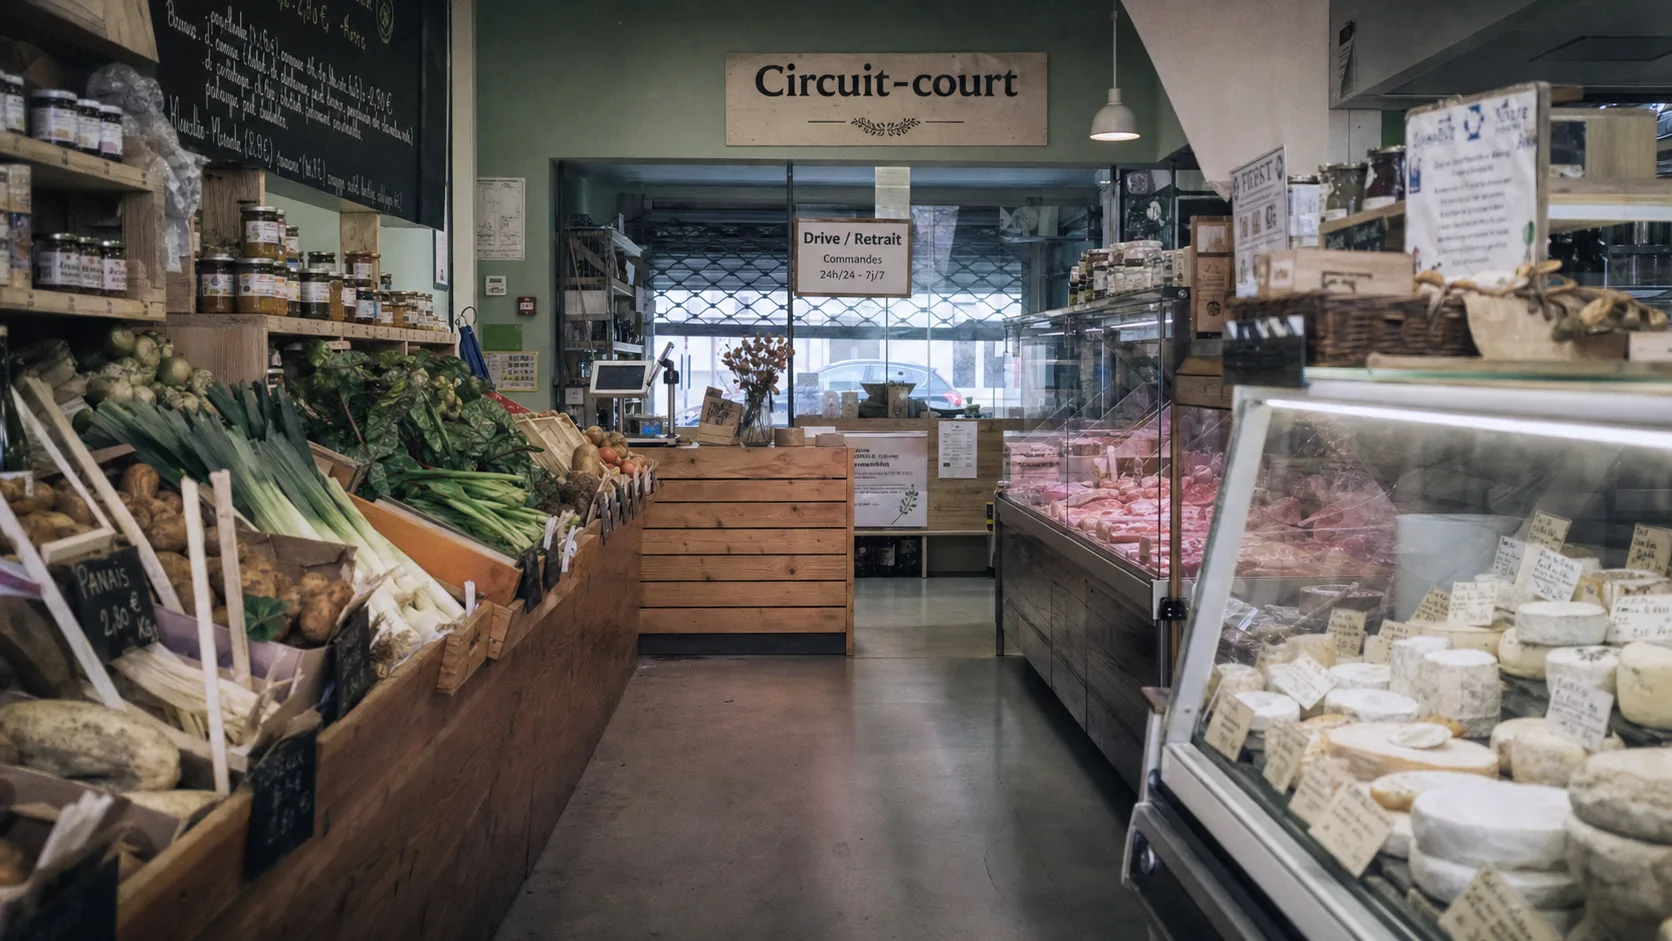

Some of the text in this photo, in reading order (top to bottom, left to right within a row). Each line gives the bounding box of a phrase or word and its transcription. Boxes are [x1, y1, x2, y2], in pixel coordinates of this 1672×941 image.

[755, 63, 1018, 97] Circuit-court
[804, 232, 902, 246] Drive / Retrait
[823, 254, 882, 265] Commandes
[820, 270, 855, 281] 24h/24
[866, 270, 885, 281] 7j/7
[76, 561, 130, 600] PANAIS
